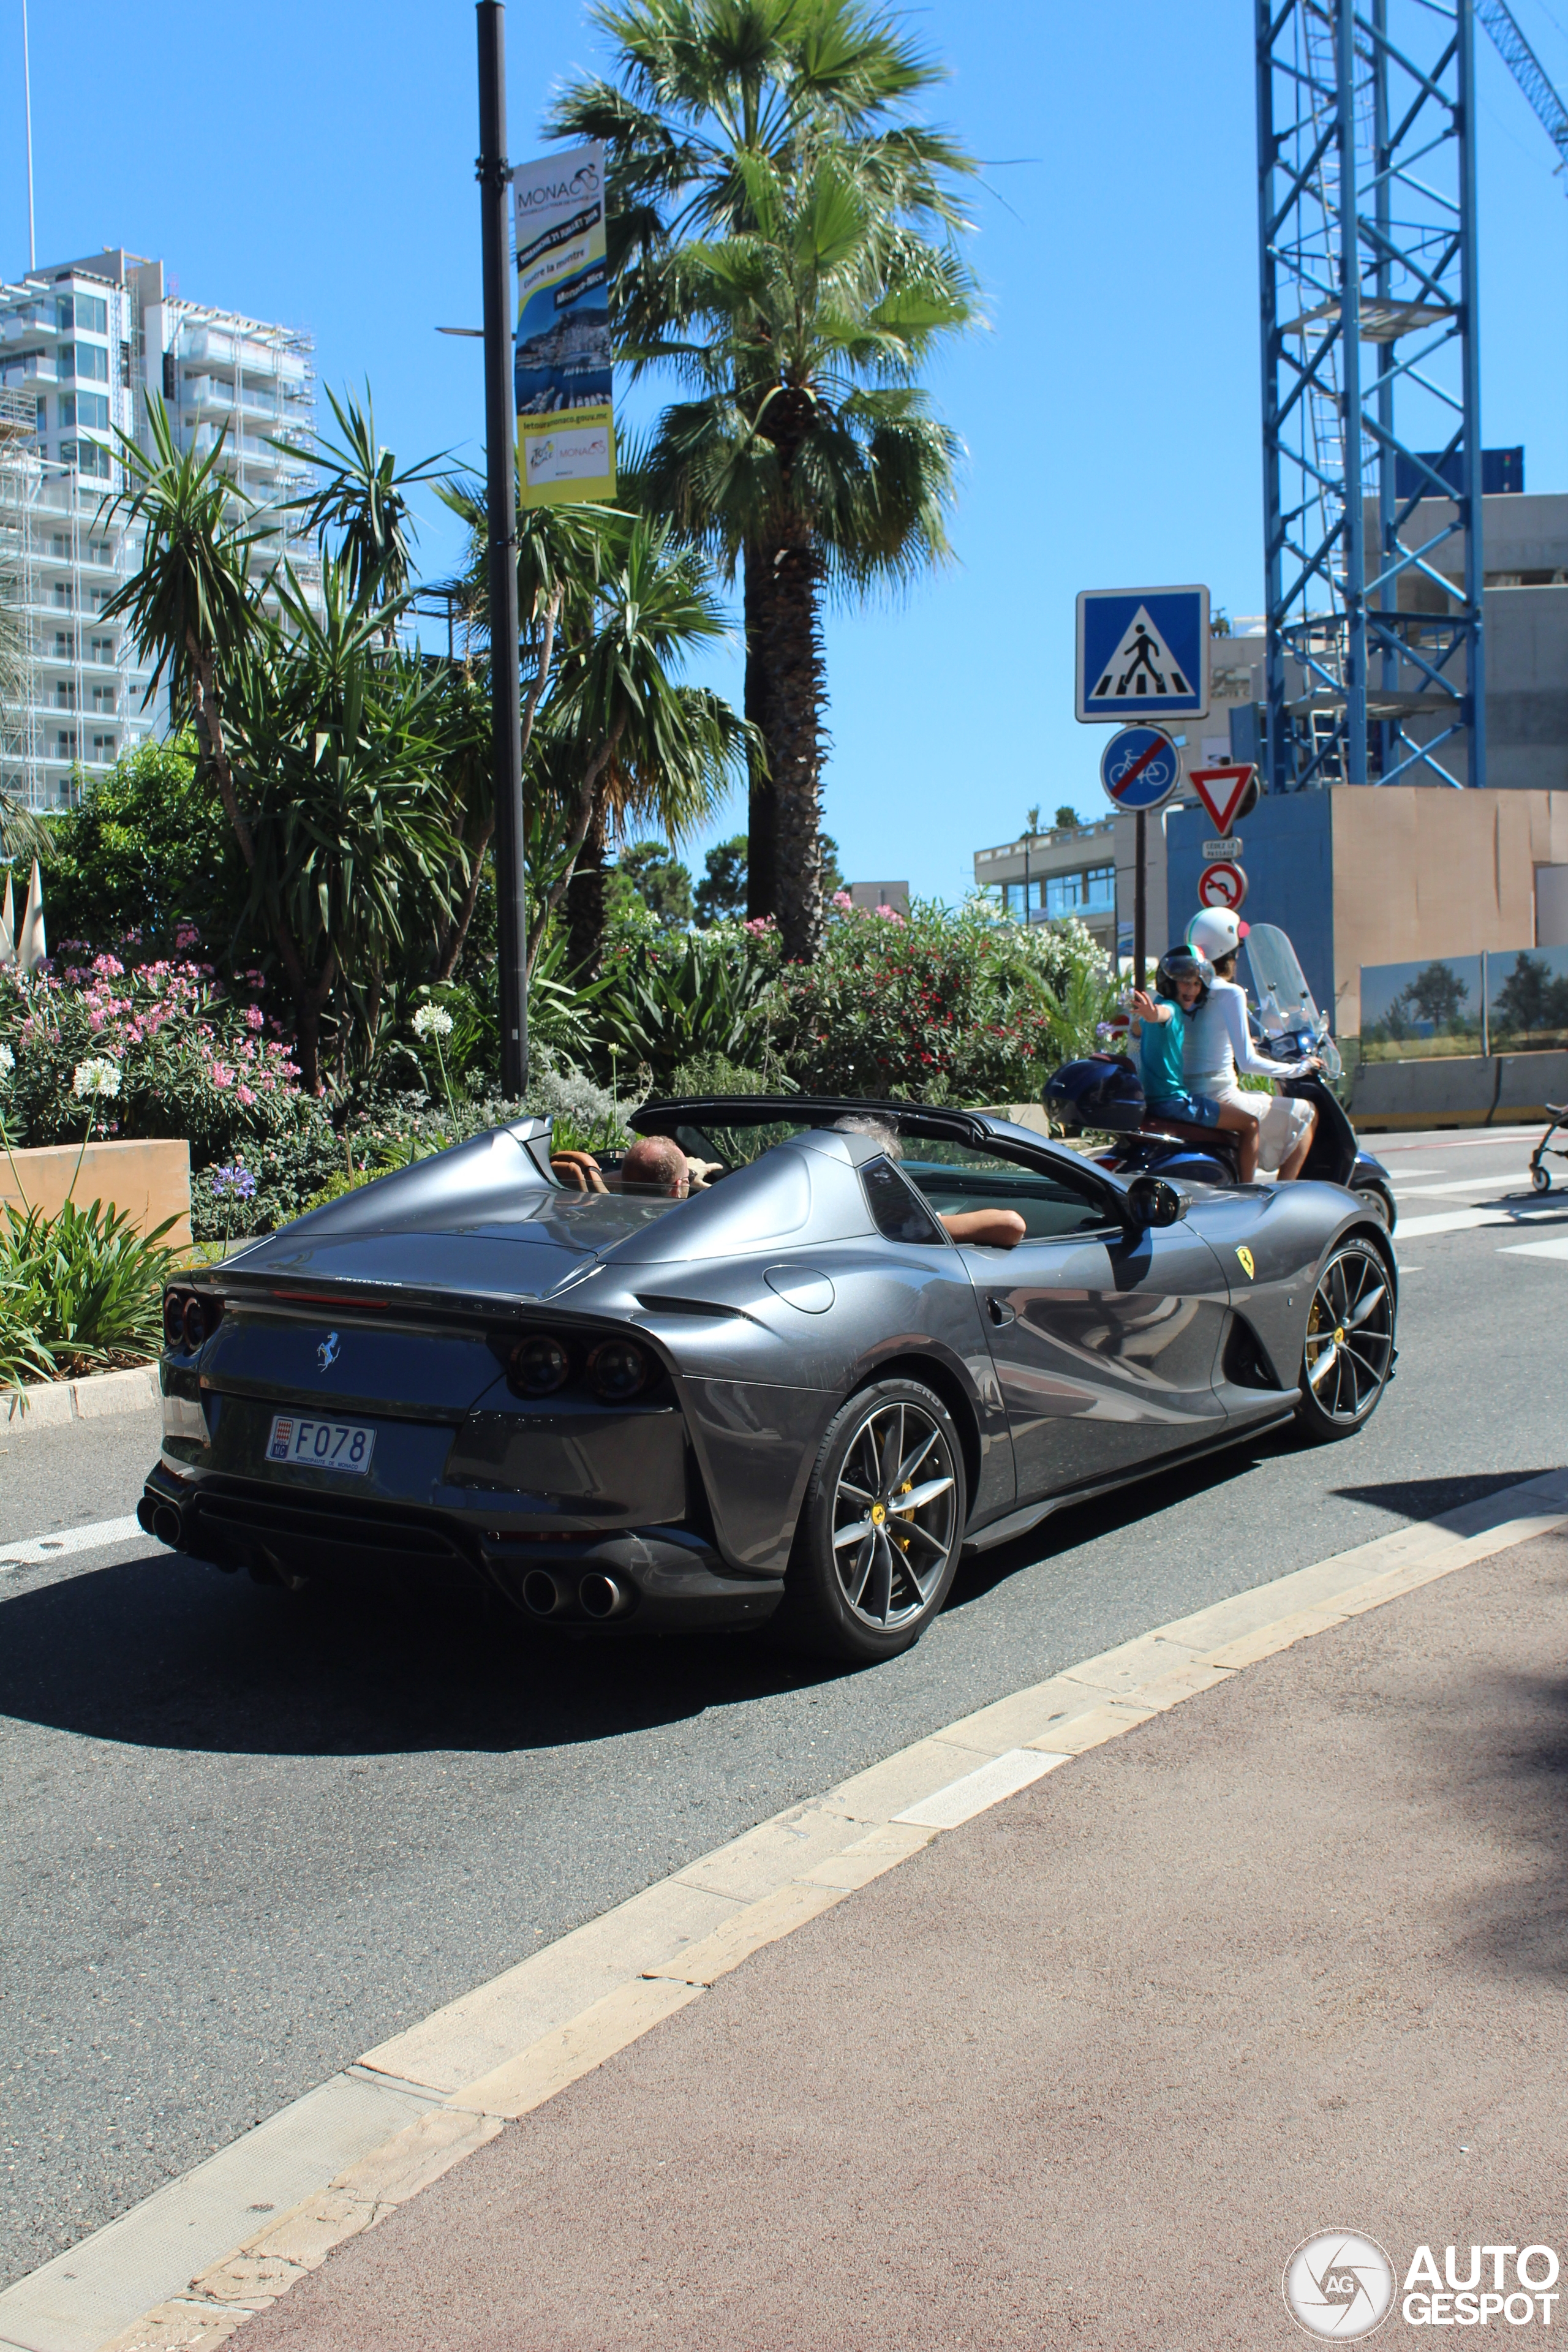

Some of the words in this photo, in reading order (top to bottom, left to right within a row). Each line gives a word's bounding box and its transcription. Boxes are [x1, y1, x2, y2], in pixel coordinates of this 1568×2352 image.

[518, 168, 599, 208] MONACO
[546, 263, 555, 274] la
[902, 1382, 941, 1408] ZERO
[274, 1446, 285, 1456] MC
[295, 1422, 366, 1462] F078
[296, 1456, 326, 1464] PRINCIPAUTE
